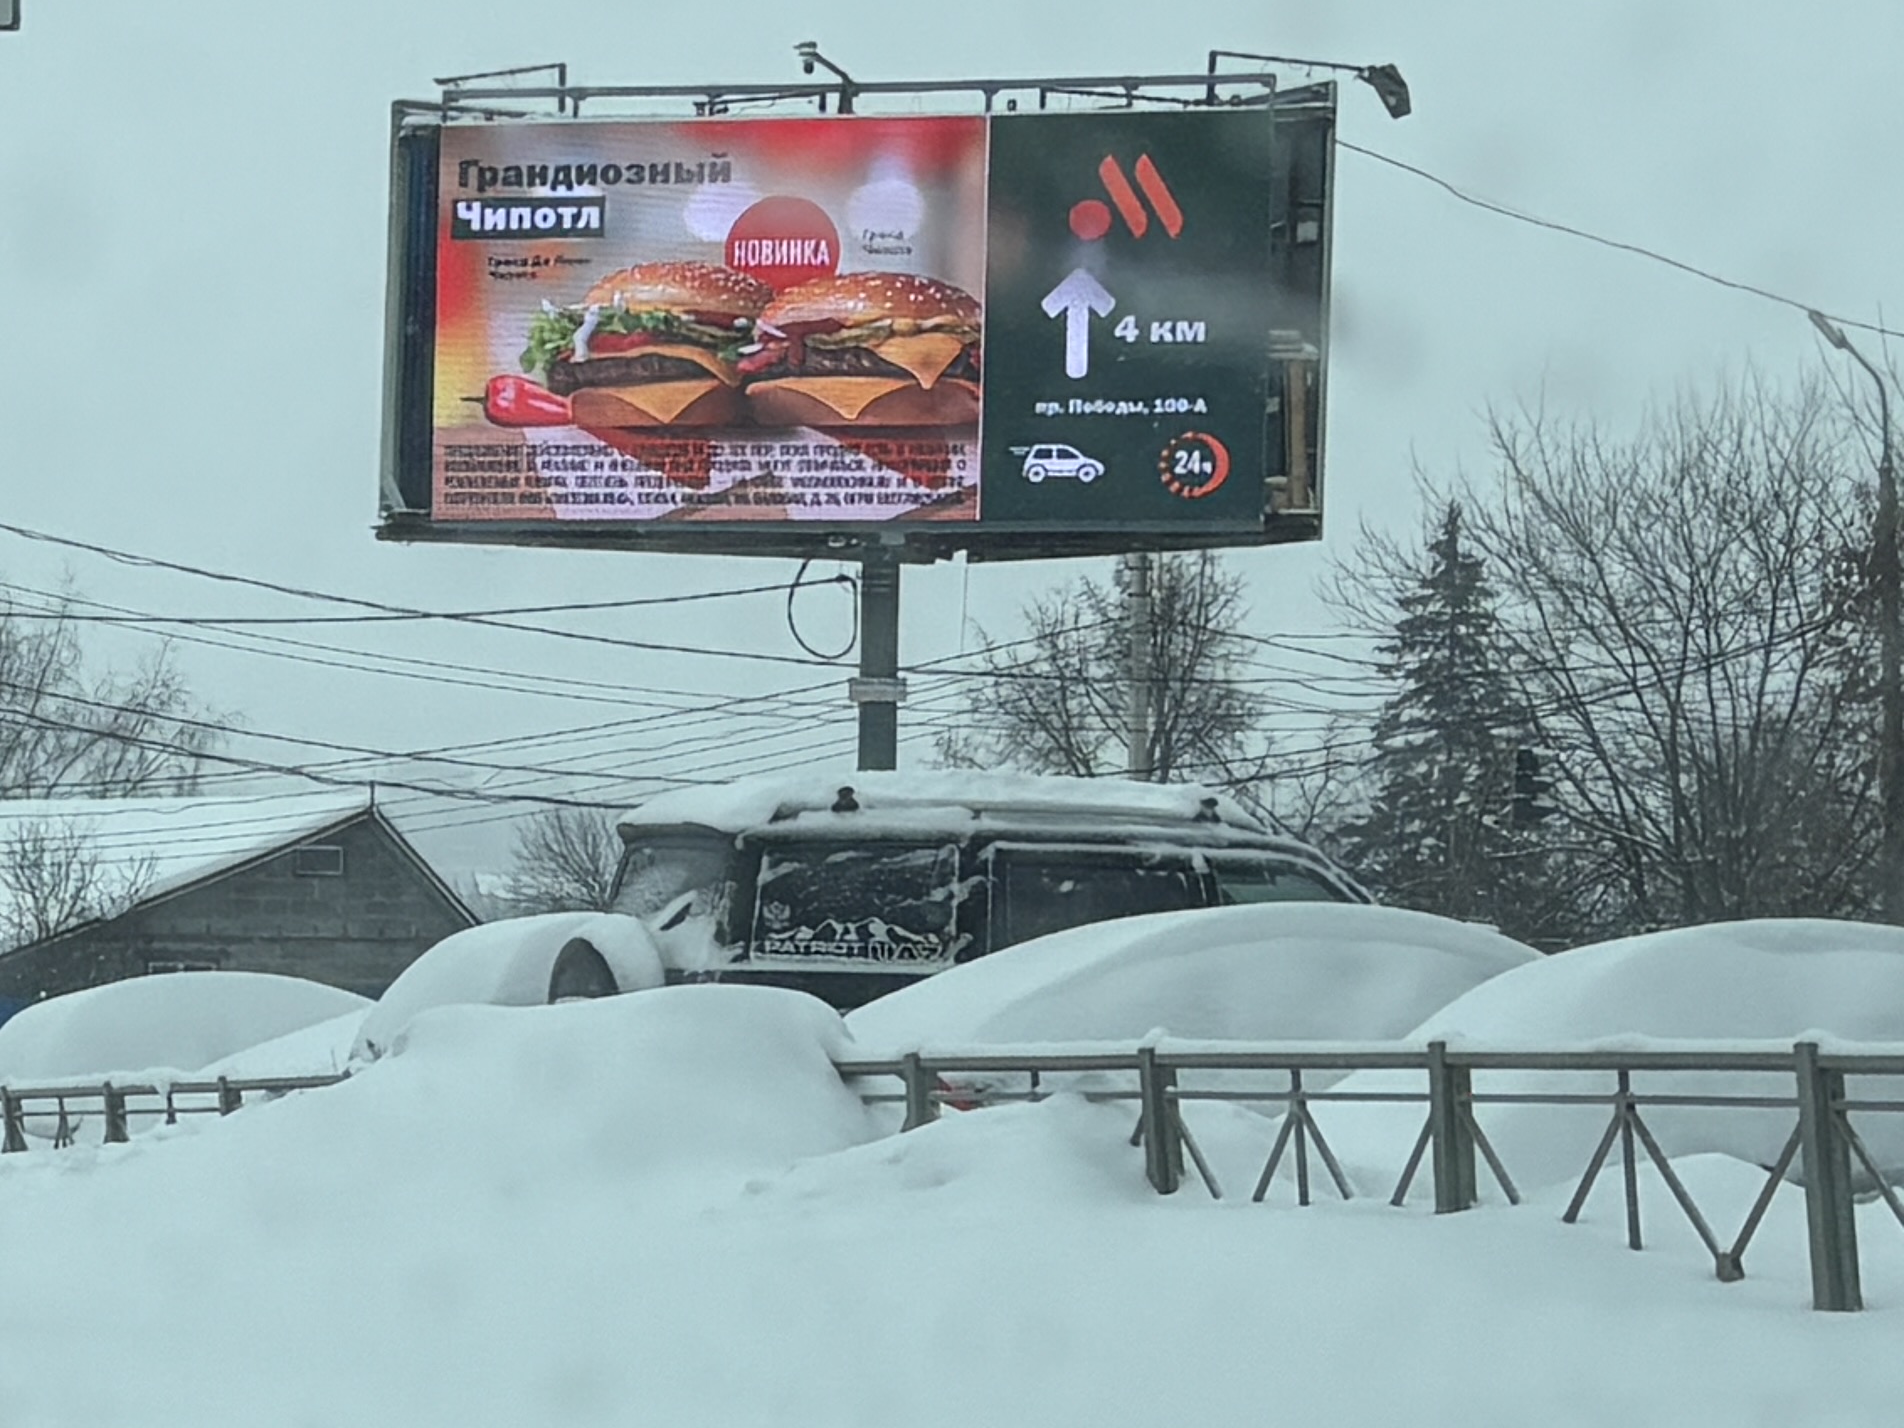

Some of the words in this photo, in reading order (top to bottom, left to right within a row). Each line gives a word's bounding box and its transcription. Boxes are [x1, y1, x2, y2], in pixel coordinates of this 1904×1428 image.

[457, 152, 733, 193] Грандиозный
[455, 199, 603, 234] Чипотл
[732, 236, 831, 269] НОВИНКА
[1114, 315, 1140, 343] 4
[1150, 320, 1206, 343] км
[1034, 401, 1065, 416] пр.
[1068, 398, 1149, 415] Победы,
[763, 940, 866, 955] PATRIOT
